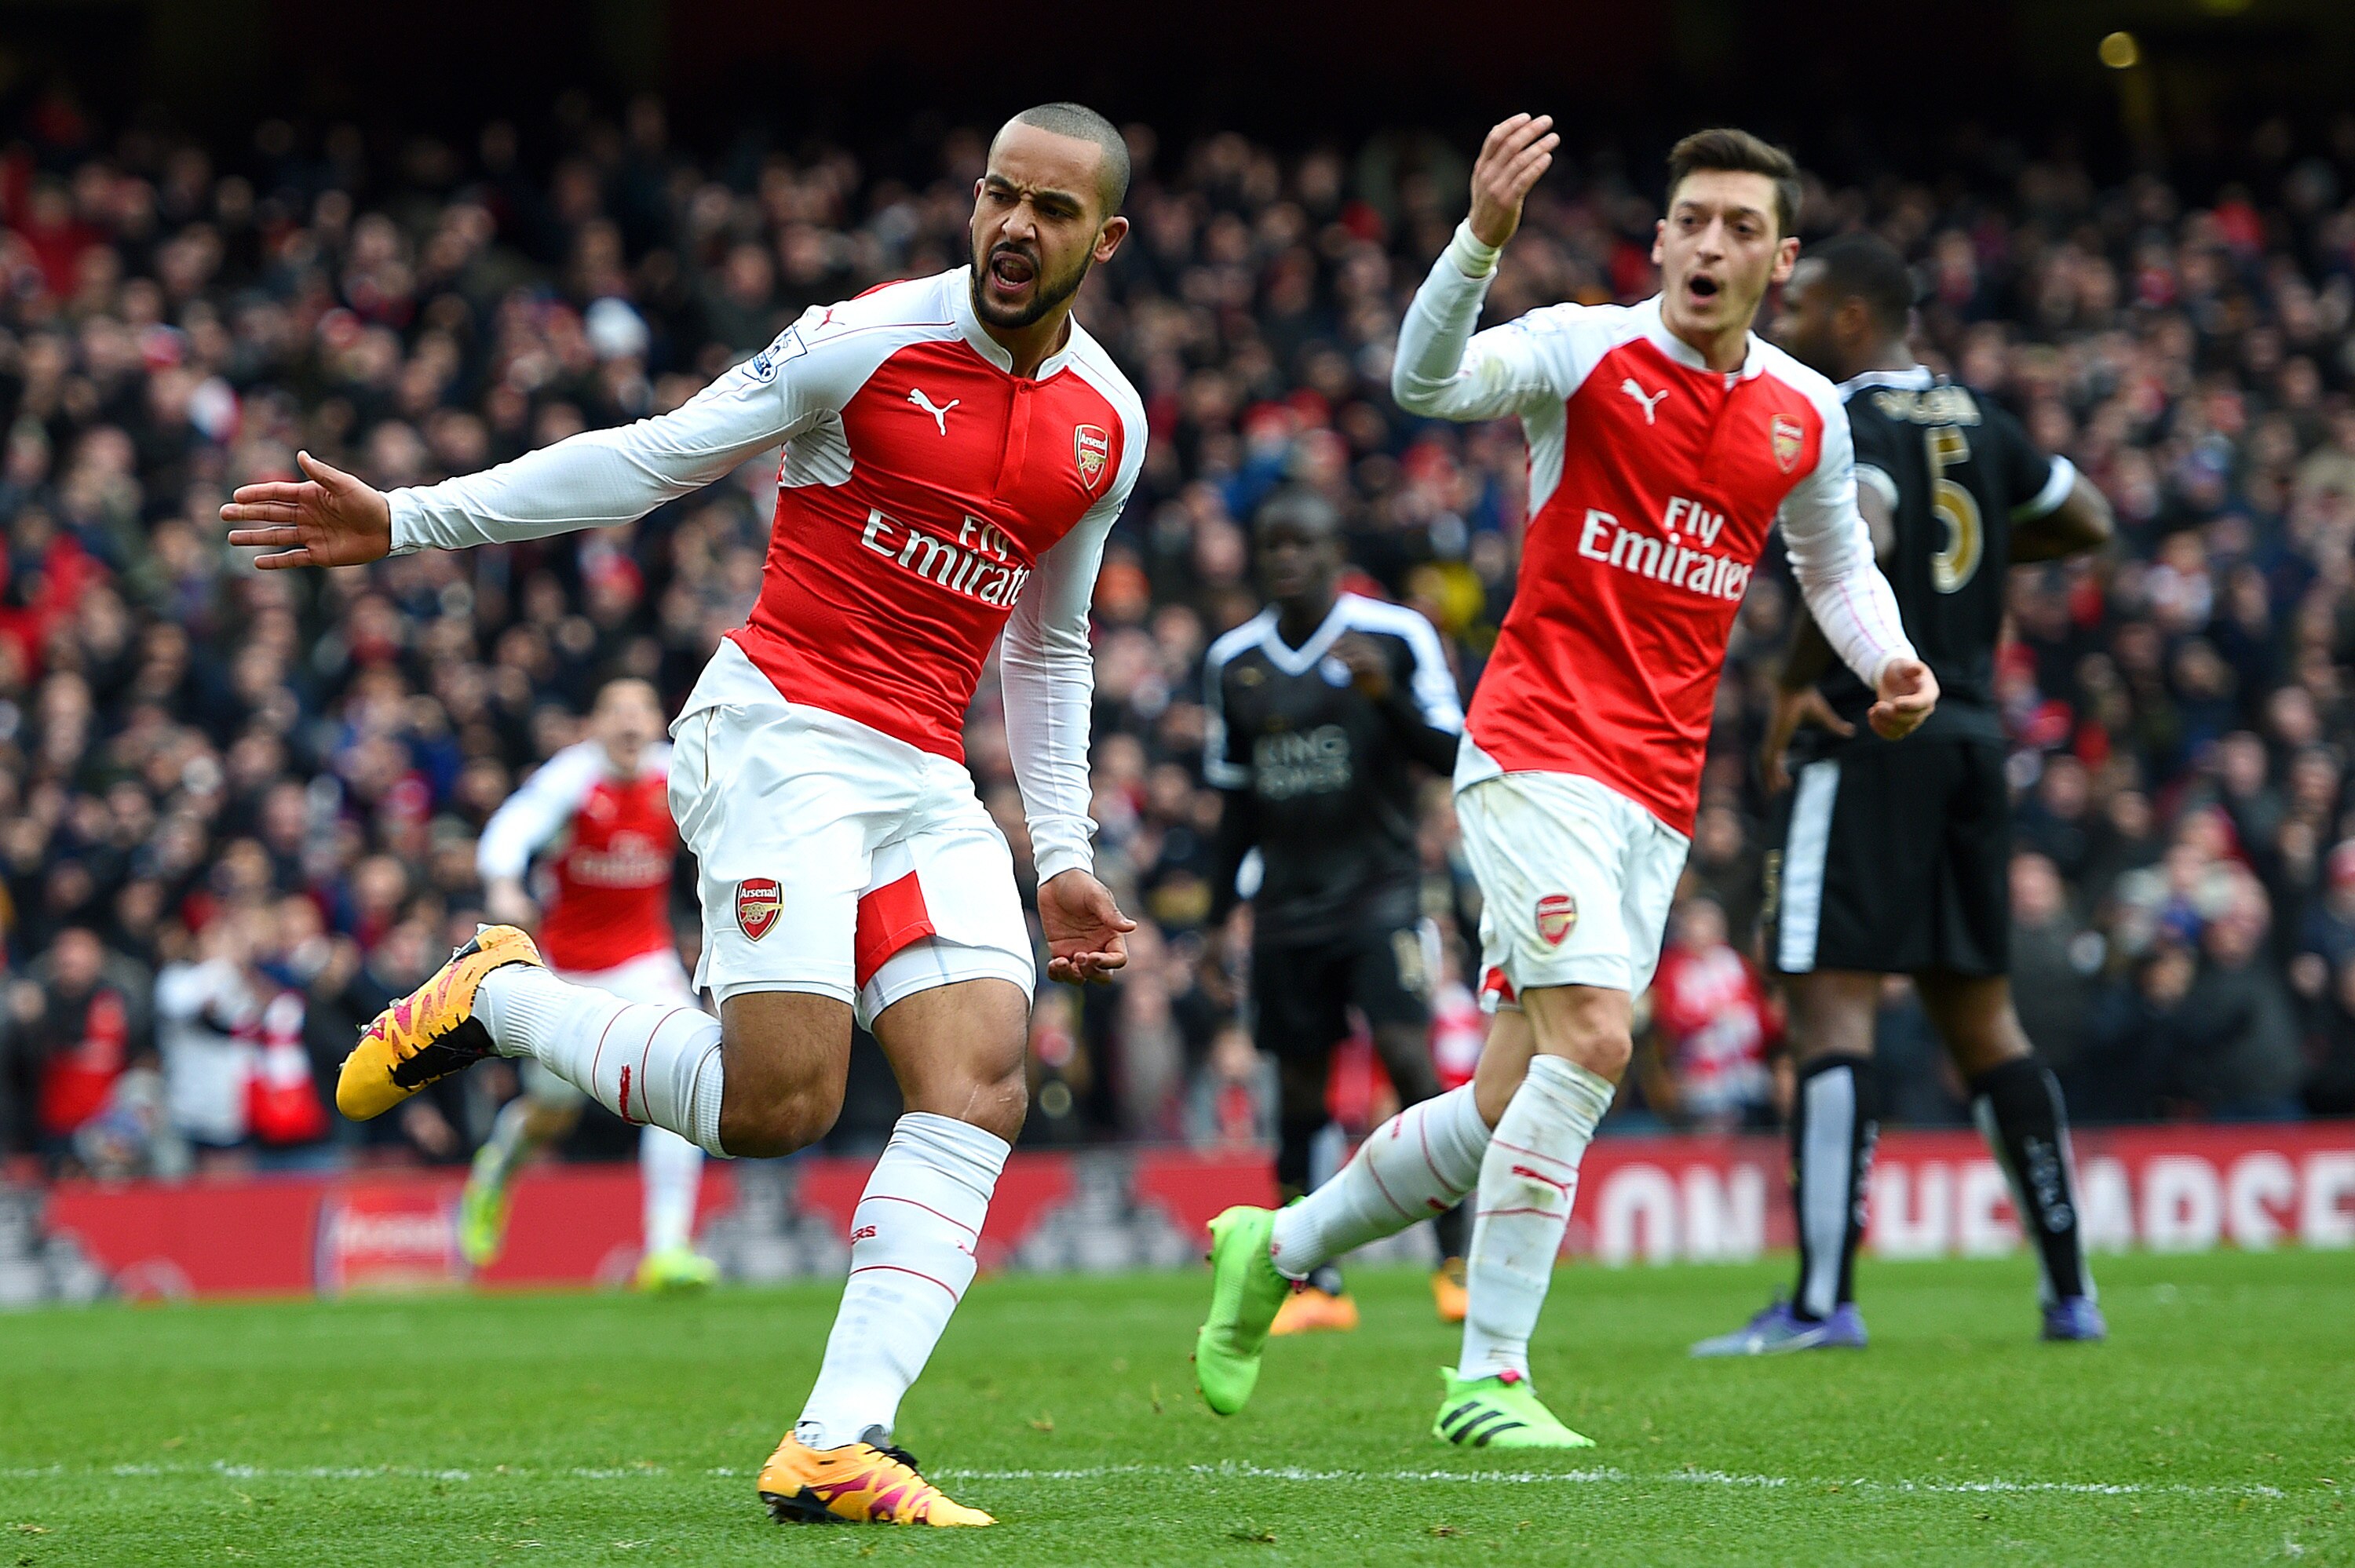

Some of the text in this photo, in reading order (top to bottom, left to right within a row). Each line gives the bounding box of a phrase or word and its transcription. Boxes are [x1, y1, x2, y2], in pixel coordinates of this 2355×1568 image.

[958, 515, 1010, 562] Fly
[1663, 495, 1725, 548] Fly
[1925, 424, 1984, 593] 5
[1578, 508, 1752, 602] Emirates
[740, 887, 776, 898] Arsenal
[1597, 1161, 1766, 1268] ON
